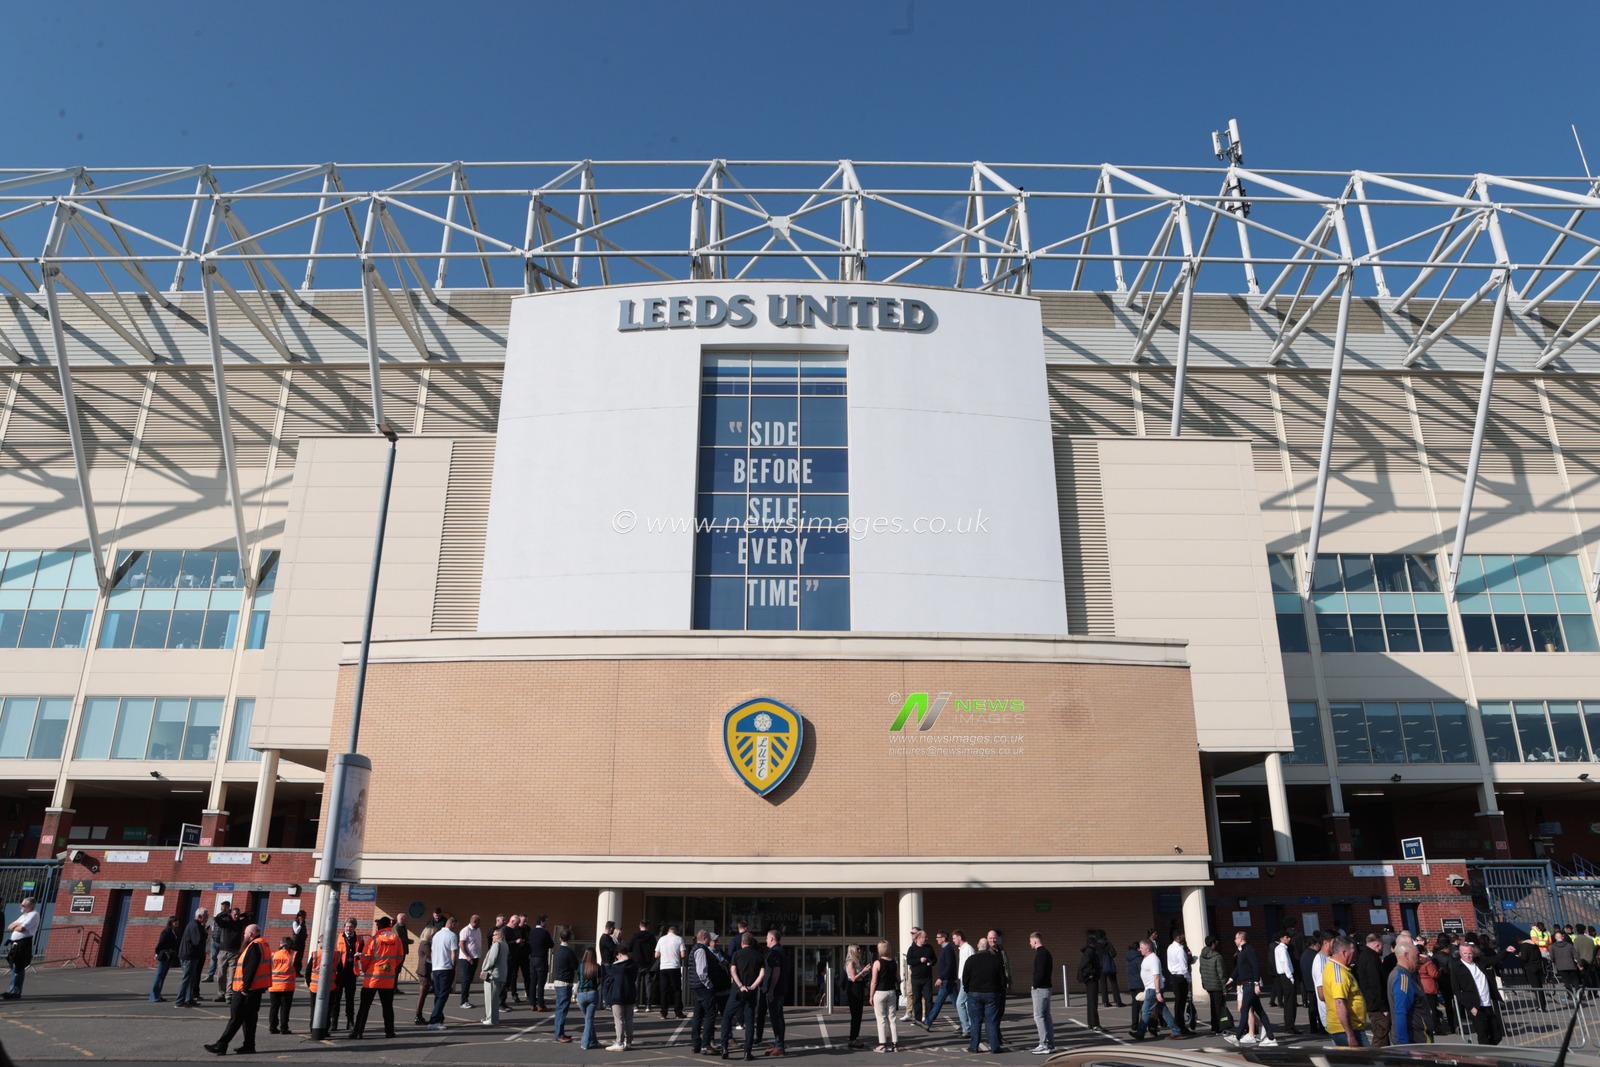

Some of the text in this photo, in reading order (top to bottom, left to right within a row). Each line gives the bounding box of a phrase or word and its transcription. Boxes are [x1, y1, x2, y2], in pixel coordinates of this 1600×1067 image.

[618, 294, 936, 332] LEEDS UNITED
[733, 458, 813, 484] BEFORE
[749, 497, 798, 525] SELF
[738, 537, 808, 565] EVERY
